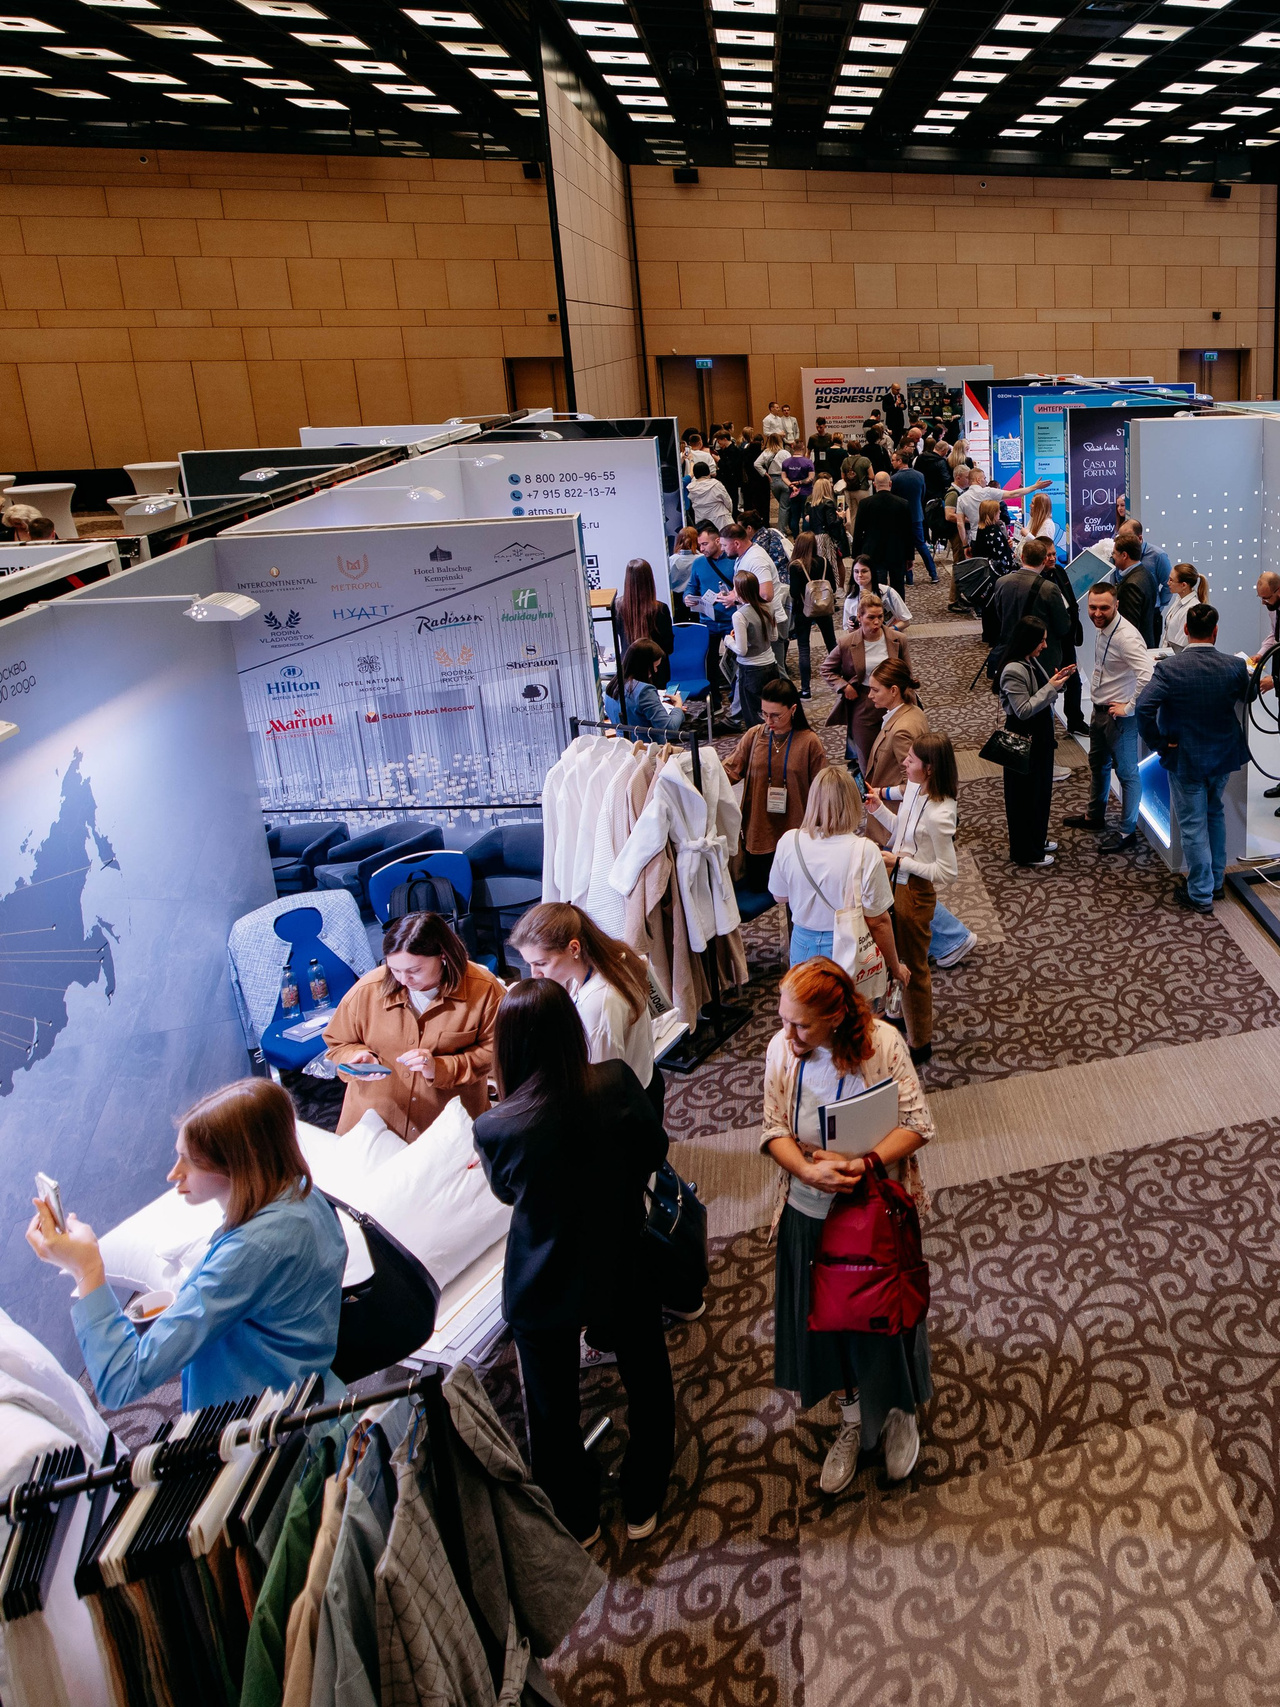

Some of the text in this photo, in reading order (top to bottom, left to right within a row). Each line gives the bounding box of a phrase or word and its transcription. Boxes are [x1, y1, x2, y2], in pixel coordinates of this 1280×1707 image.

[815, 386, 892, 395] HOSPITALITY
[815, 395, 873, 404] BUSINESS
[1083, 459, 1117, 469] CASA DI
[525, 471, 616, 484] 8 800 200-96-55
[1084, 469, 1116, 478] FORTUNA
[526, 487, 616, 499] +7 915 822-13-74
[1082, 488, 1116, 505] PIOLI
[528, 508, 567, 516] atms.ru
[1084, 516, 1101, 525] Cosy
[1084, 523, 1115, 532] &Trendy
[414, 565, 472, 575] Hotel Baltschug
[424, 574, 464, 583] Kempinski
[331, 581, 382, 592] METROPOL
[333, 604, 390, 621] HYATT
[501, 611, 553, 622] Holiday Inn
[415, 611, 483, 635] Radisson
[260, 634, 314, 644] VLADIVOSTOK
[506, 658, 558, 671] Sheraton
[441, 669, 473, 677] RODINA
[338, 676, 404, 688] HOTEL NATIONAL
[266, 681, 320, 695] Hilton
[382, 704, 475, 720] Soluxe Hotel Moscow
[266, 712, 336, 735] Marriott
